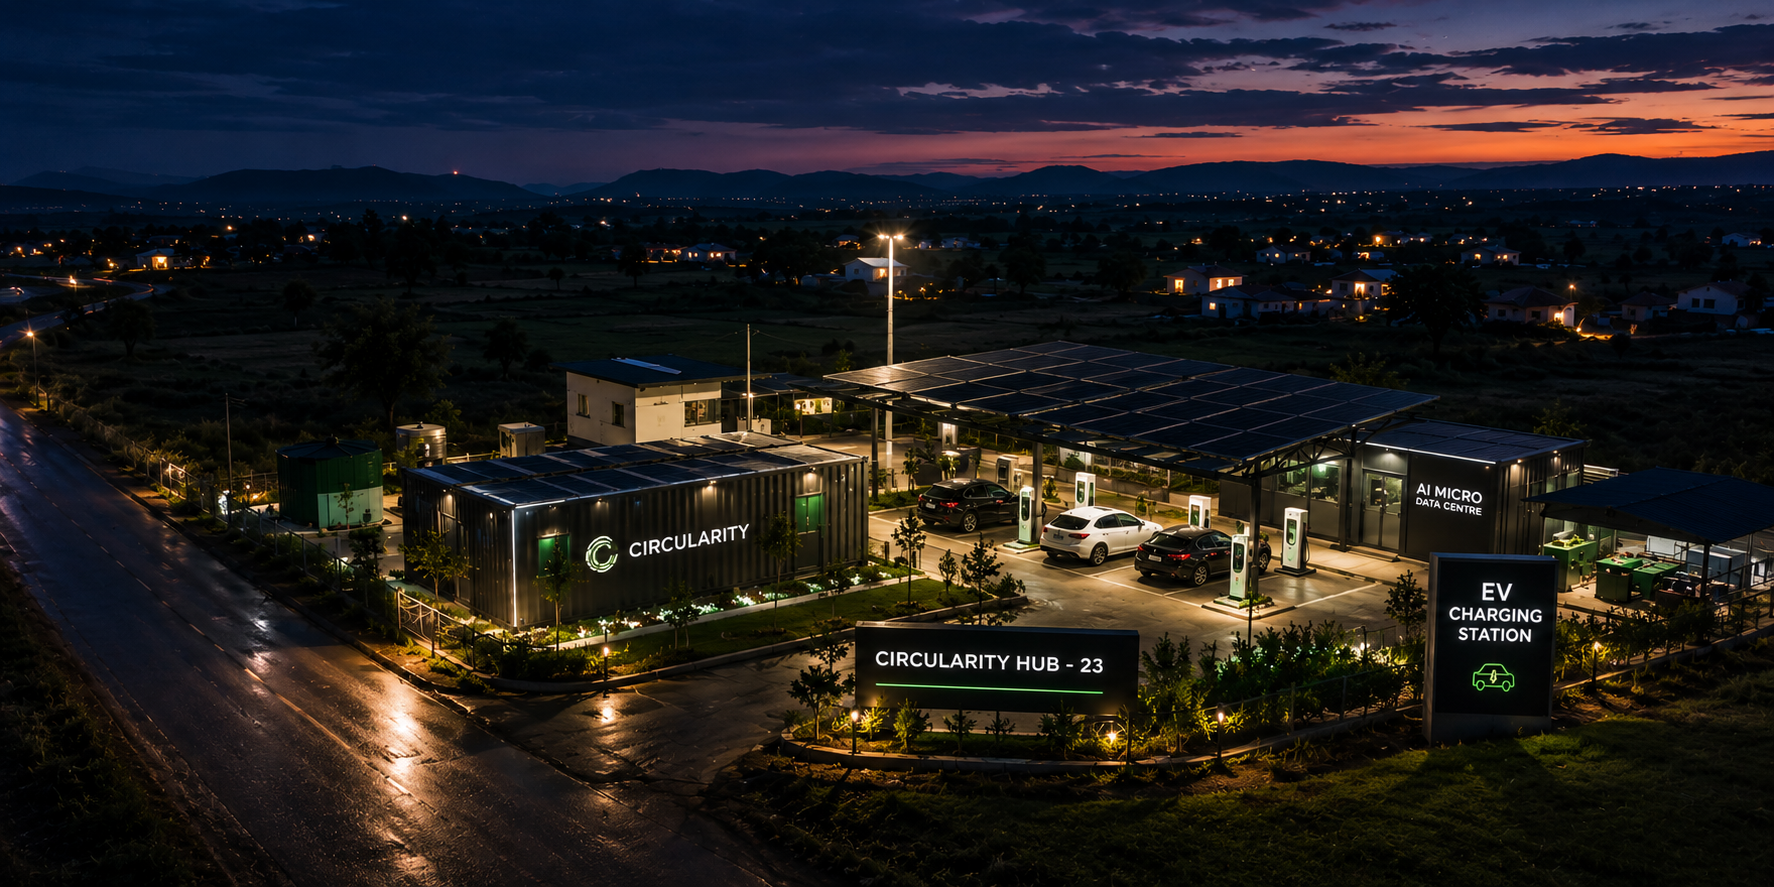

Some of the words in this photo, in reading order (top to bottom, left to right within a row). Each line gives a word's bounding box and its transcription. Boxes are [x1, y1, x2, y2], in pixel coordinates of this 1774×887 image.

[1416, 482, 1431, 496] AI
[1434, 485, 1483, 504] MICRO
[1415, 497, 1441, 509] DATA
[1443, 501, 1482, 516] CENTRE
[628, 523, 750, 558] CIRCULARITY
[1481, 582, 1513, 602] EV
[1448, 606, 1543, 624] CHARGING
[1457, 626, 1532, 643] STATION
[875, 650, 1010, 671] CIRCULARITY
[1016, 655, 1060, 672] HUB
[1080, 657, 1104, 674] 23
